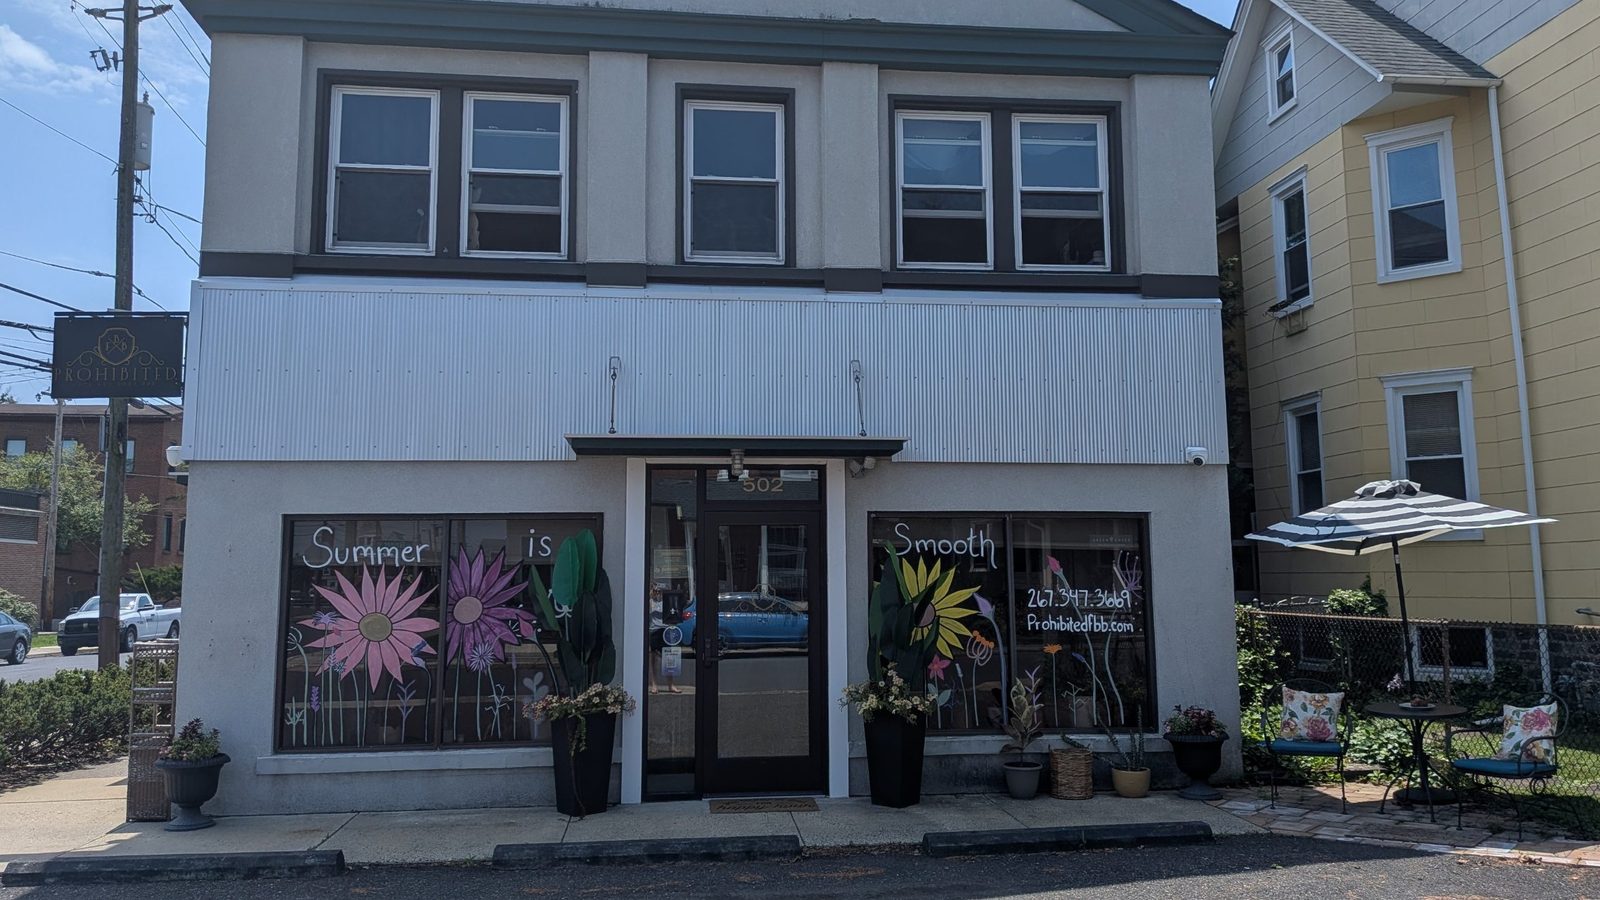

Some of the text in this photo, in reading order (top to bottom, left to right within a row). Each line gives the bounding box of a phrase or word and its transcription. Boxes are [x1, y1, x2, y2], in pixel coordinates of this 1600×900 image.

[54, 367, 178, 382] PROHIBITED
[743, 477, 784, 492] 502
[302, 525, 552, 569] Summer is
[894, 522, 998, 570] Smooth
[1027, 588, 1132, 608] 267.347.3669
[1027, 613, 1134, 633] Prohibitedfbb.com
